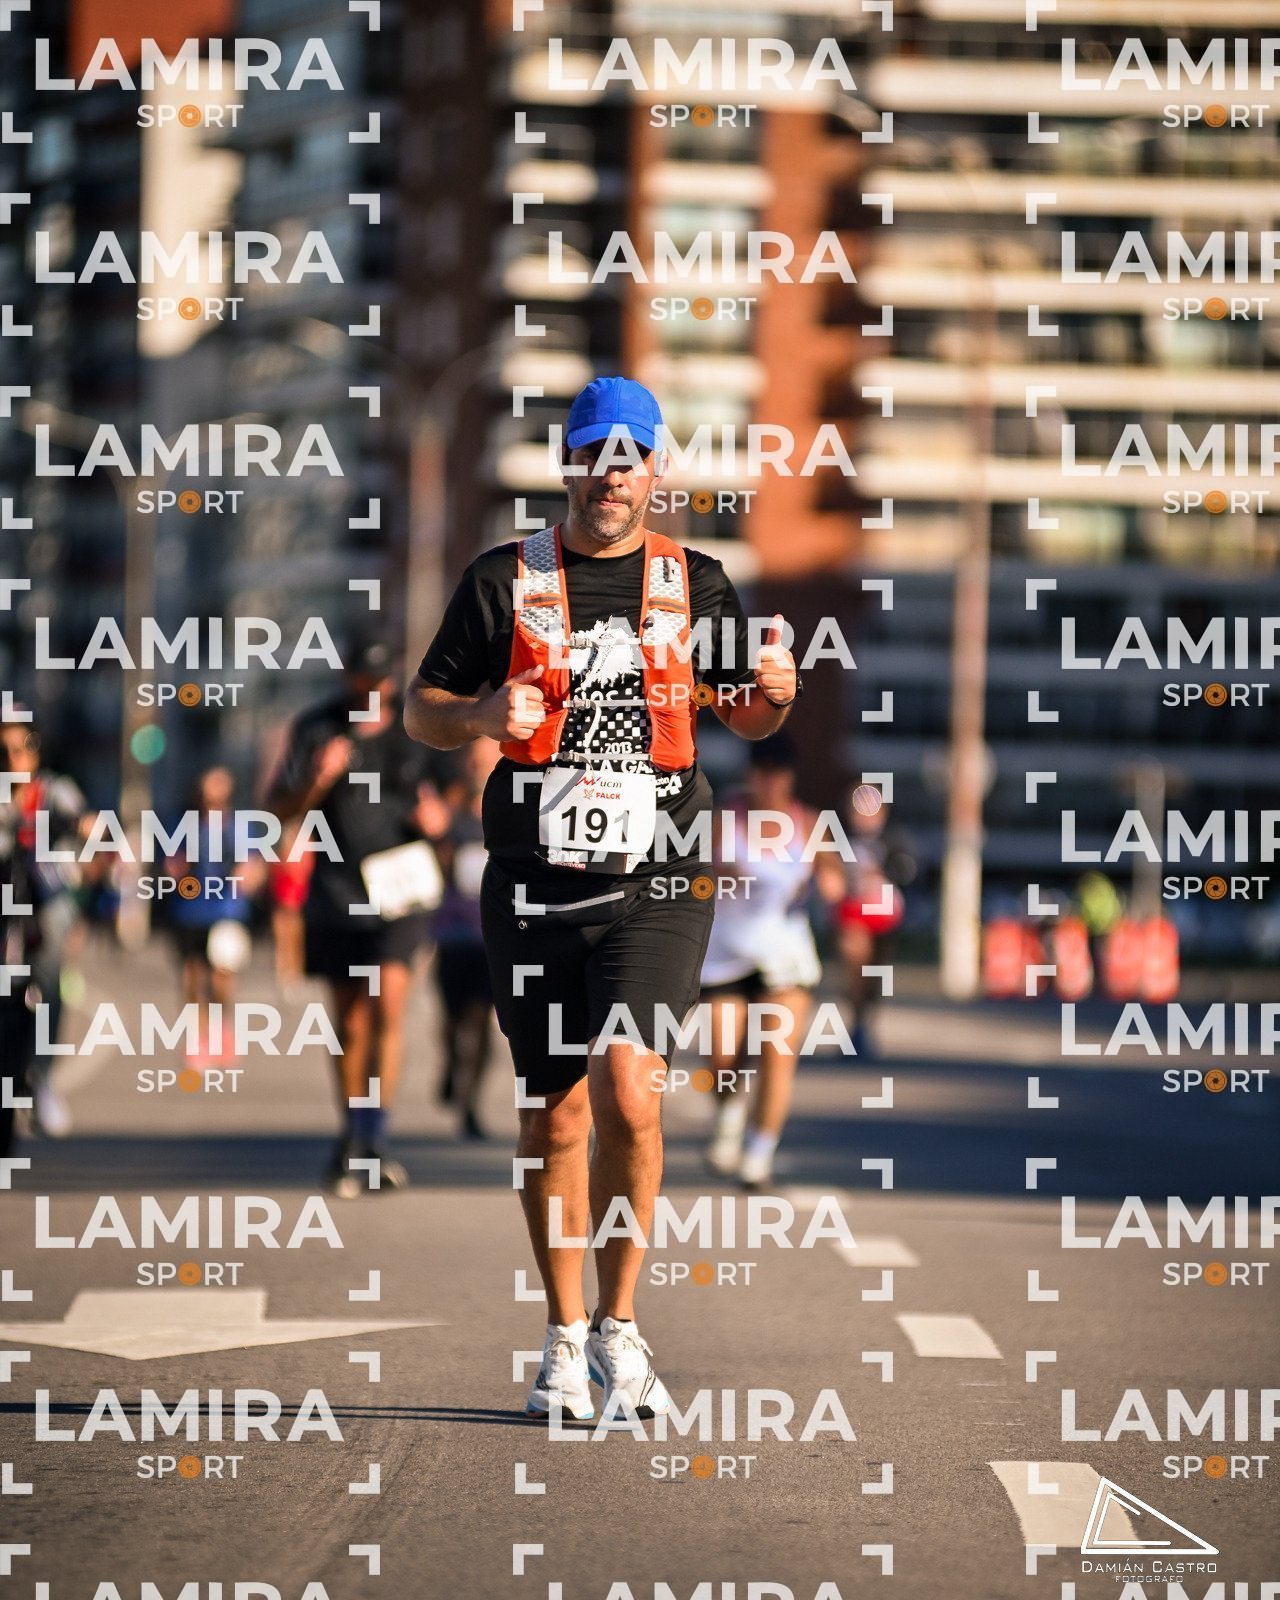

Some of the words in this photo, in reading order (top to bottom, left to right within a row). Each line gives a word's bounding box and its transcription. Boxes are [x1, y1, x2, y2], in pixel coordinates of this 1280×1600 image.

[604, 741, 633, 755] 2013
[600, 781, 622, 789] ucm
[595, 792, 621, 800] FALCK
[561, 805, 630, 845] 191
